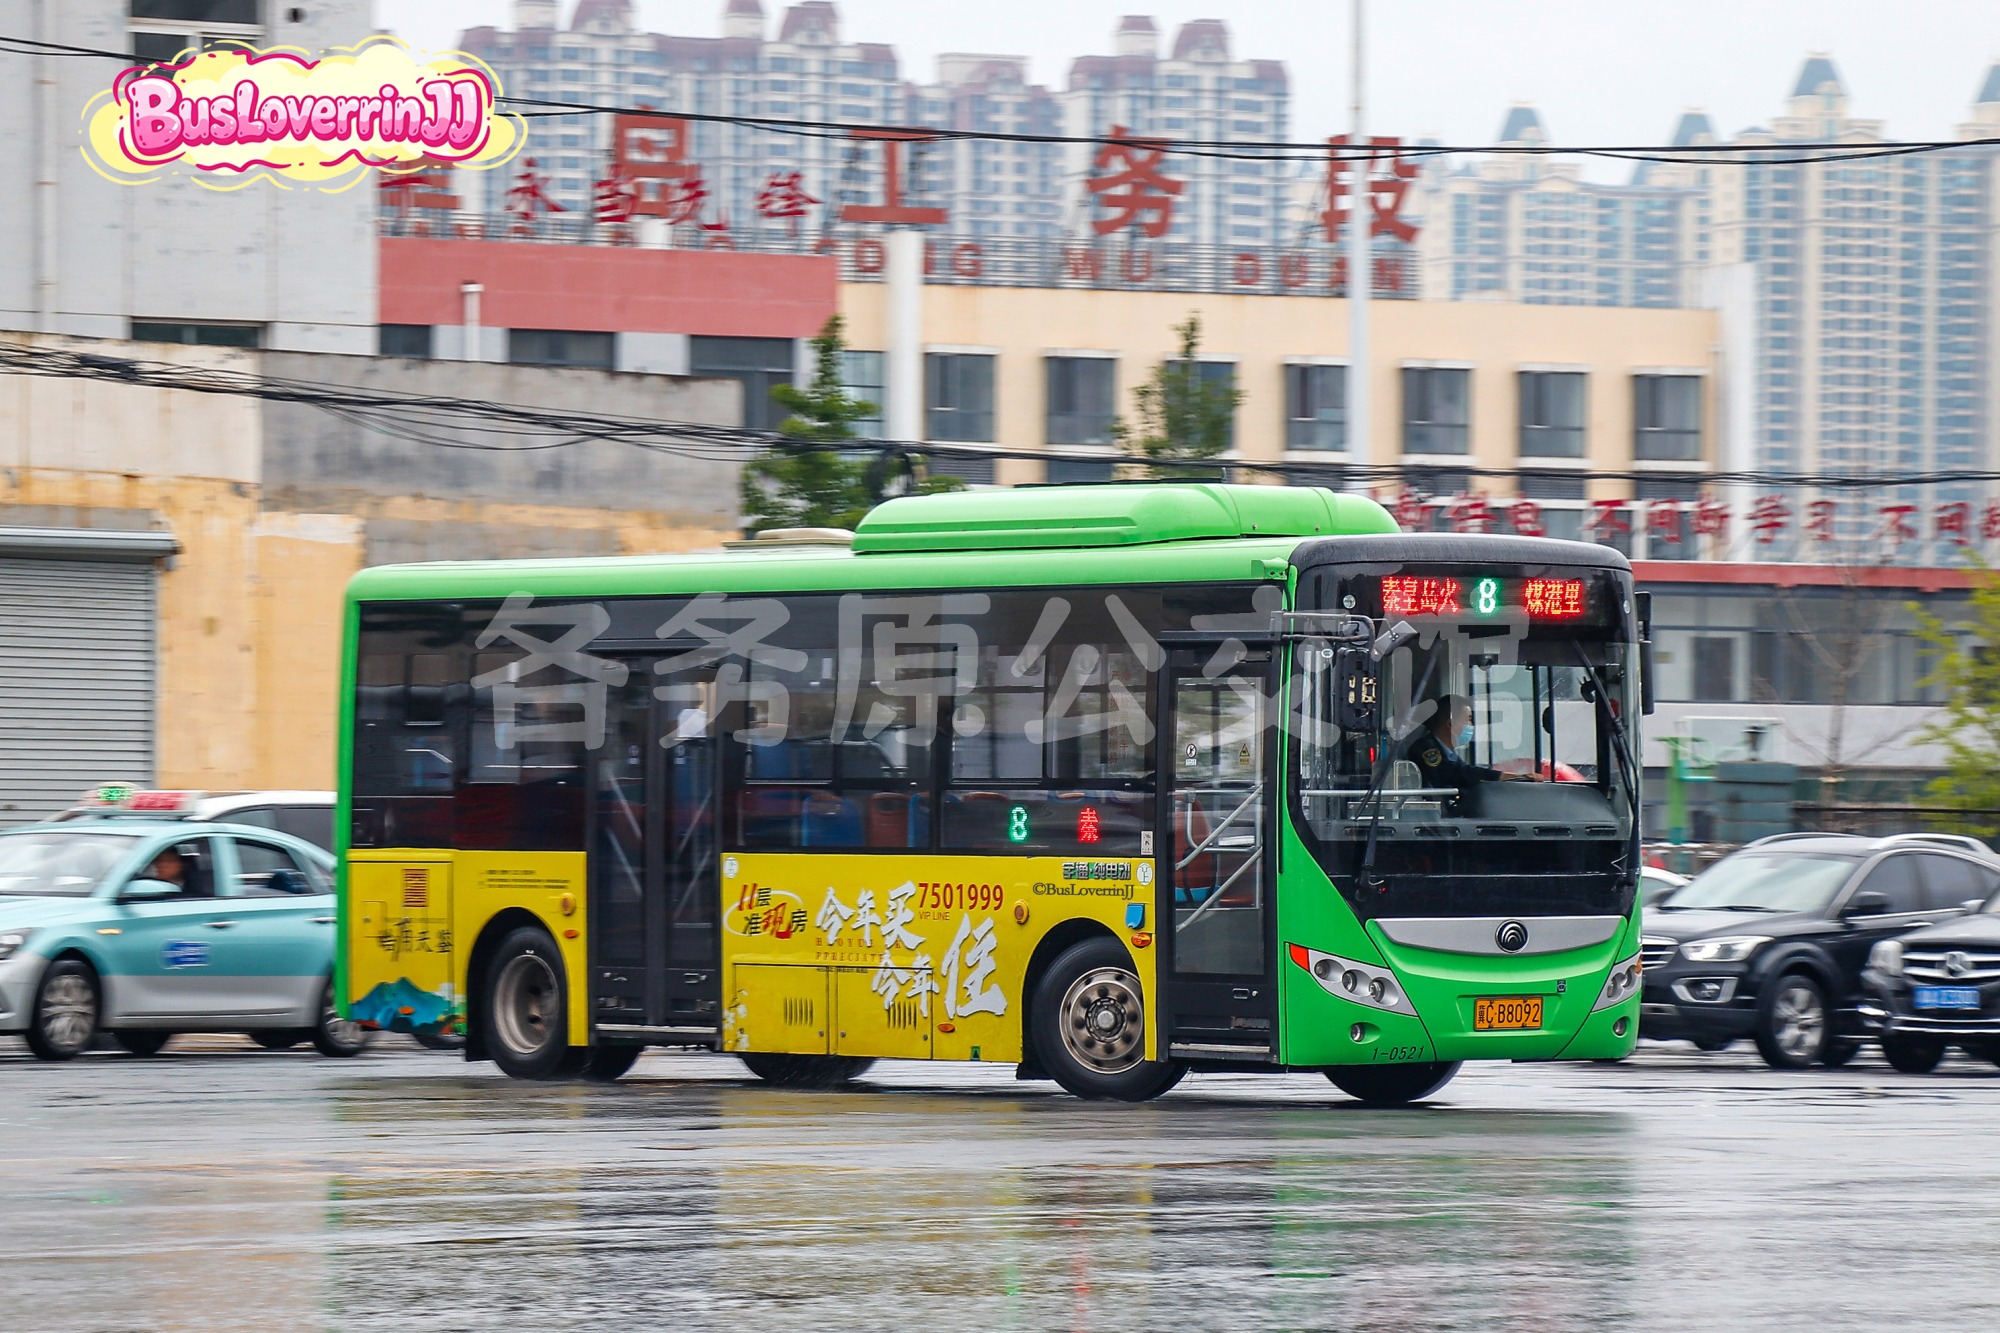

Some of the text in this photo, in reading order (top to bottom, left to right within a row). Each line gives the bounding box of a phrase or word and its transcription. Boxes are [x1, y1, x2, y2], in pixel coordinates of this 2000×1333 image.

[1478, 579, 1498, 613] 8
[1012, 807, 1099, 841] 8 秦
[918, 882, 1004, 911] 7501999
[743, 902, 808, 939] 准现房
[815, 880, 927, 950] 今年买
[919, 911, 950, 921] VIP LINE
[1372, 1046, 1424, 1061] 1-0521
